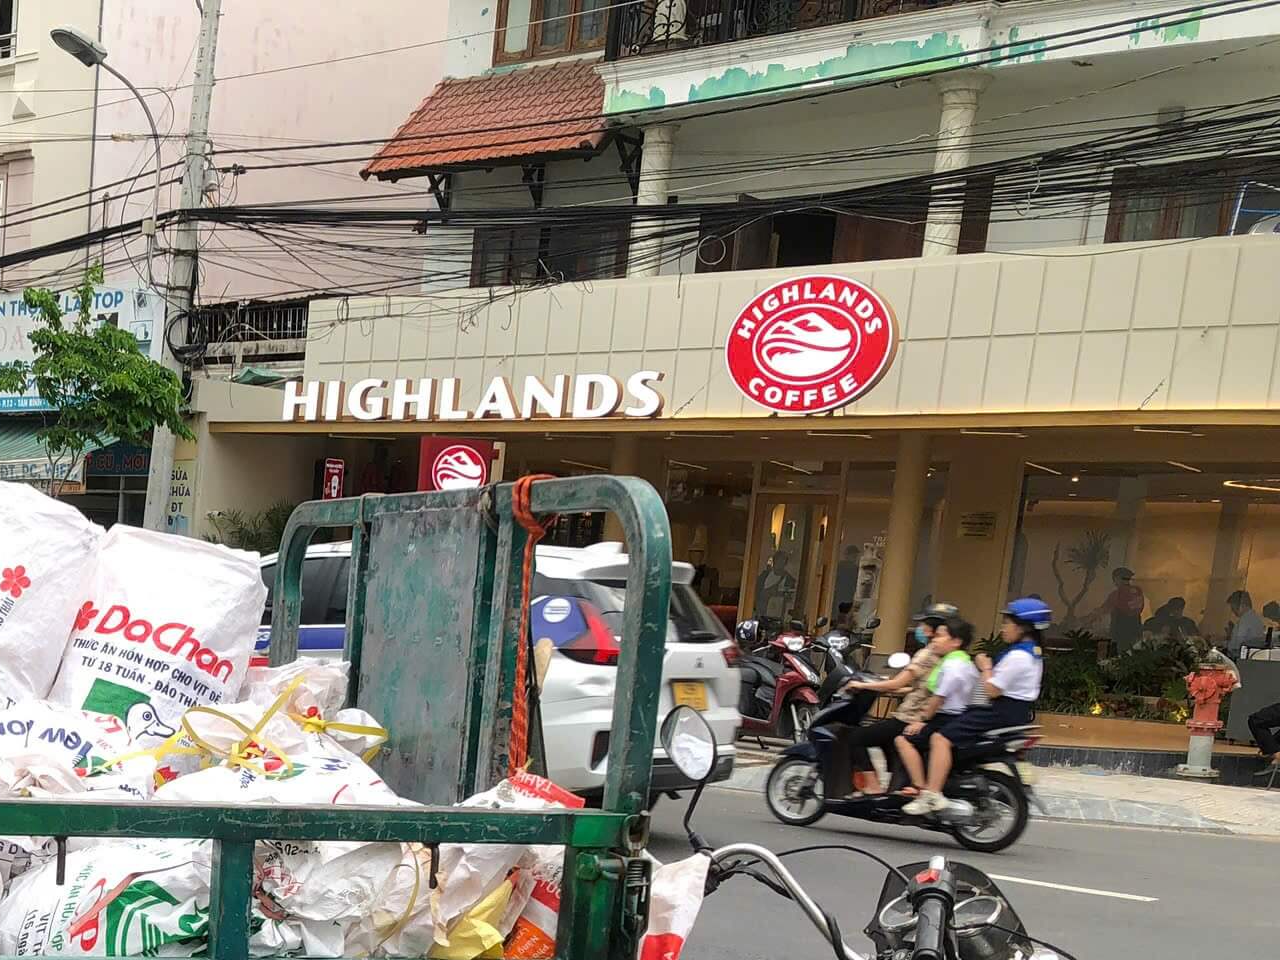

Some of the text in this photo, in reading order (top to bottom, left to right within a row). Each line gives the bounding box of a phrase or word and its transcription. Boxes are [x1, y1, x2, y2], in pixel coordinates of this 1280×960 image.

[65, 292, 124, 313] LATOP
[736, 282, 883, 340] HIGHLANDS
[282, 370, 664, 421] HIGHLANDS
[748, 372, 858, 407] COFFEE
[168, 484, 190, 498] HỮA
[172, 502, 182, 513] ĐT
[94, 604, 234, 684] DaChan
[99, 660, 112, 673] 18
[154, 680, 177, 699] ĐÀO
[145, 656, 170, 674] HỢP
[171, 668, 192, 687] CHO
[192, 678, 210, 698] VỊT
